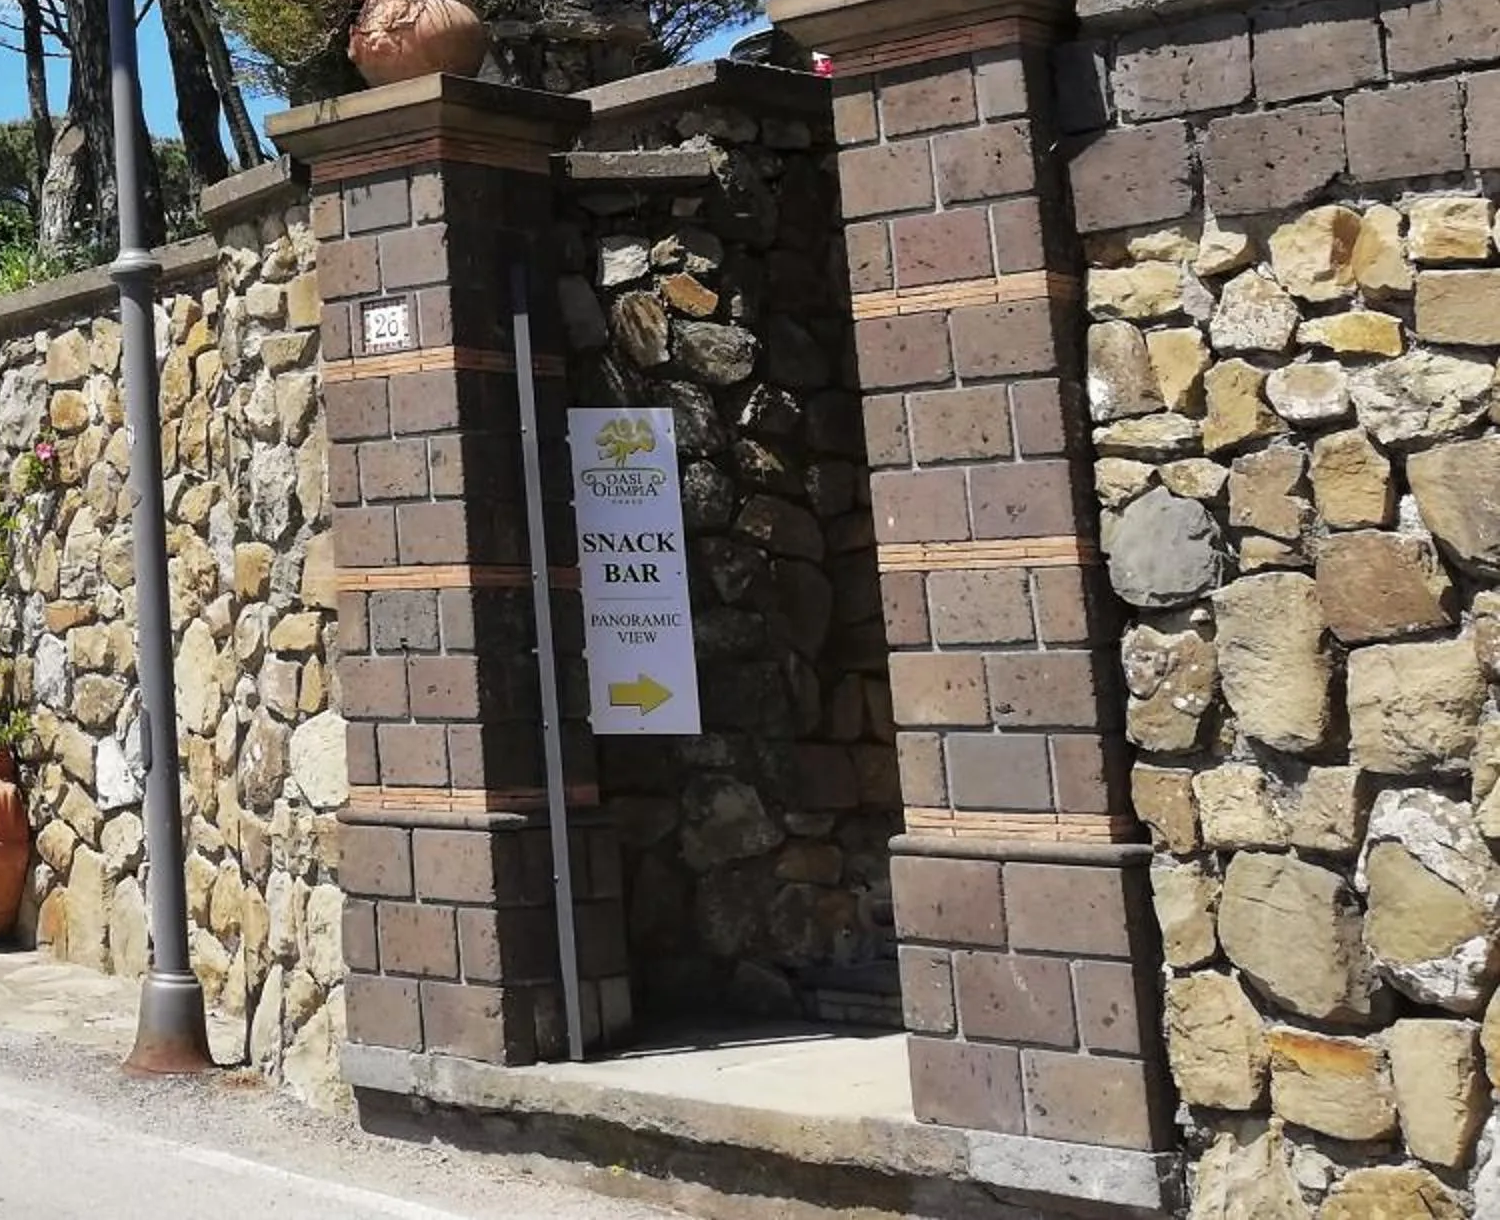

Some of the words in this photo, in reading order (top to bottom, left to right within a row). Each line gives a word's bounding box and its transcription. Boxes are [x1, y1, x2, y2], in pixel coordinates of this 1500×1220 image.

[605, 473, 642, 485] OASI
[593, 482, 658, 497] OLIMPIA
[582, 532, 676, 553] SNACK
[603, 563, 660, 583] BAR
[591, 612, 681, 627] PANORAMIC
[618, 632, 657, 644] VIEW
